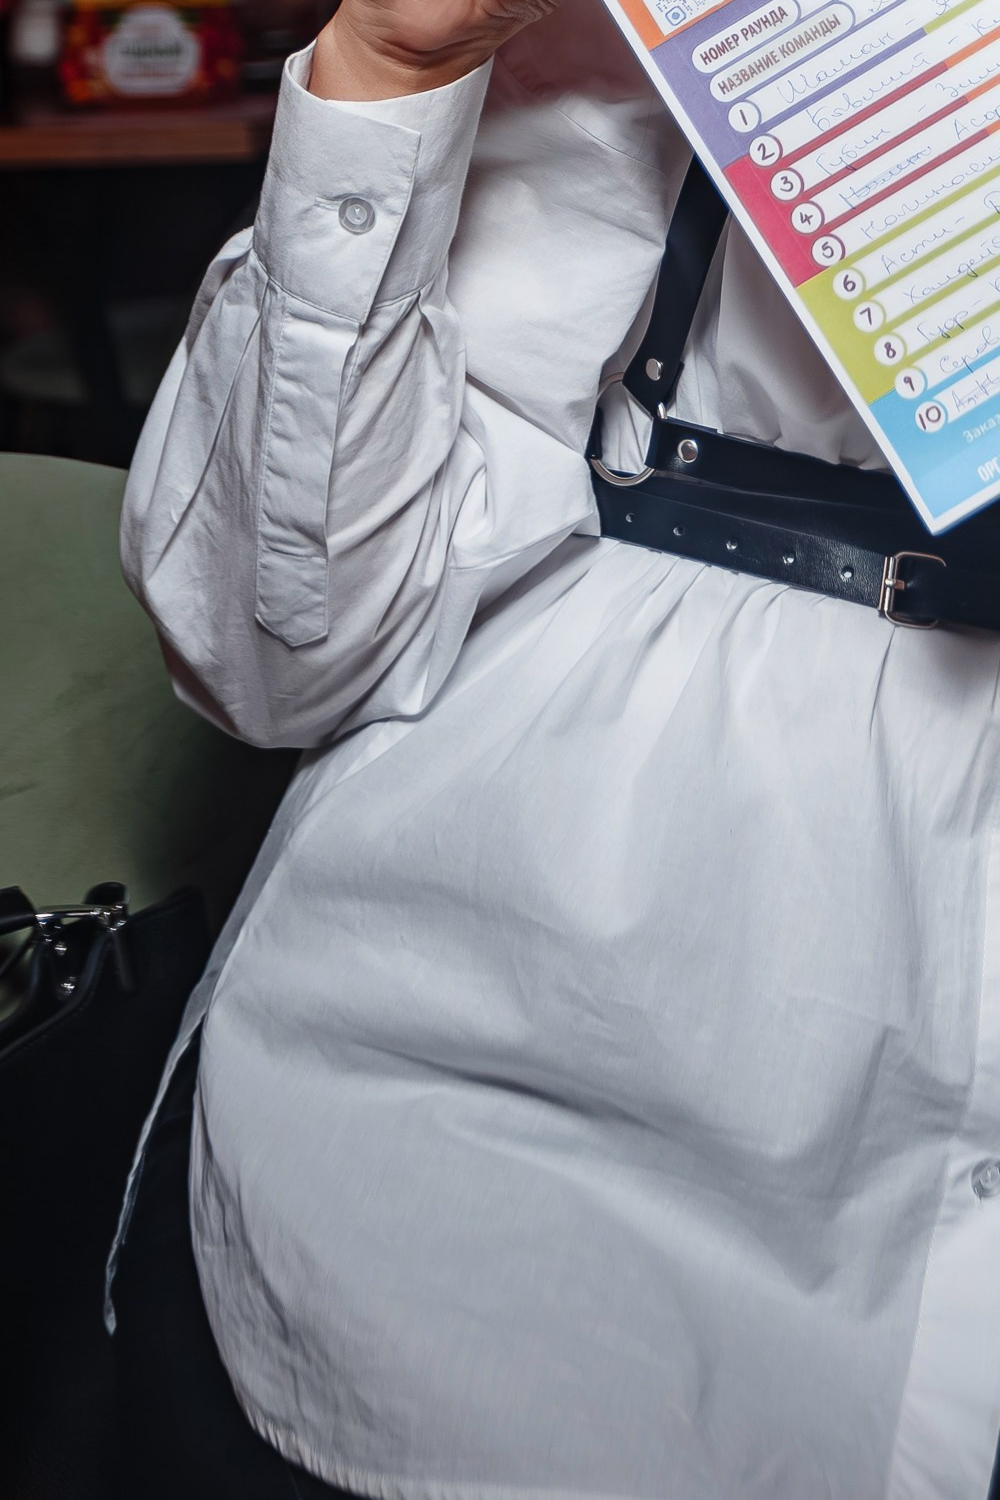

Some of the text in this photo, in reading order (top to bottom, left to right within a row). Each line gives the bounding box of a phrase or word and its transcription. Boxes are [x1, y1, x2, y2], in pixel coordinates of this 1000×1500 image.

[698, 4, 789, 66] НОМЕР РАУНДА
[717, 13, 842, 95] НАЗВАНИЕ КОМАНДЫ
[737, 108, 750, 126] 1
[754, 140, 775, 161] 2
[774, 173, 795, 195] 3
[796, 207, 816, 228] 4
[817, 240, 836, 261] 5
[838, 272, 858, 294] 6
[858, 306, 878, 327] 7
[881, 340, 898, 360] 8
[902, 374, 917, 393] 9
[915, 403, 944, 429] 10
